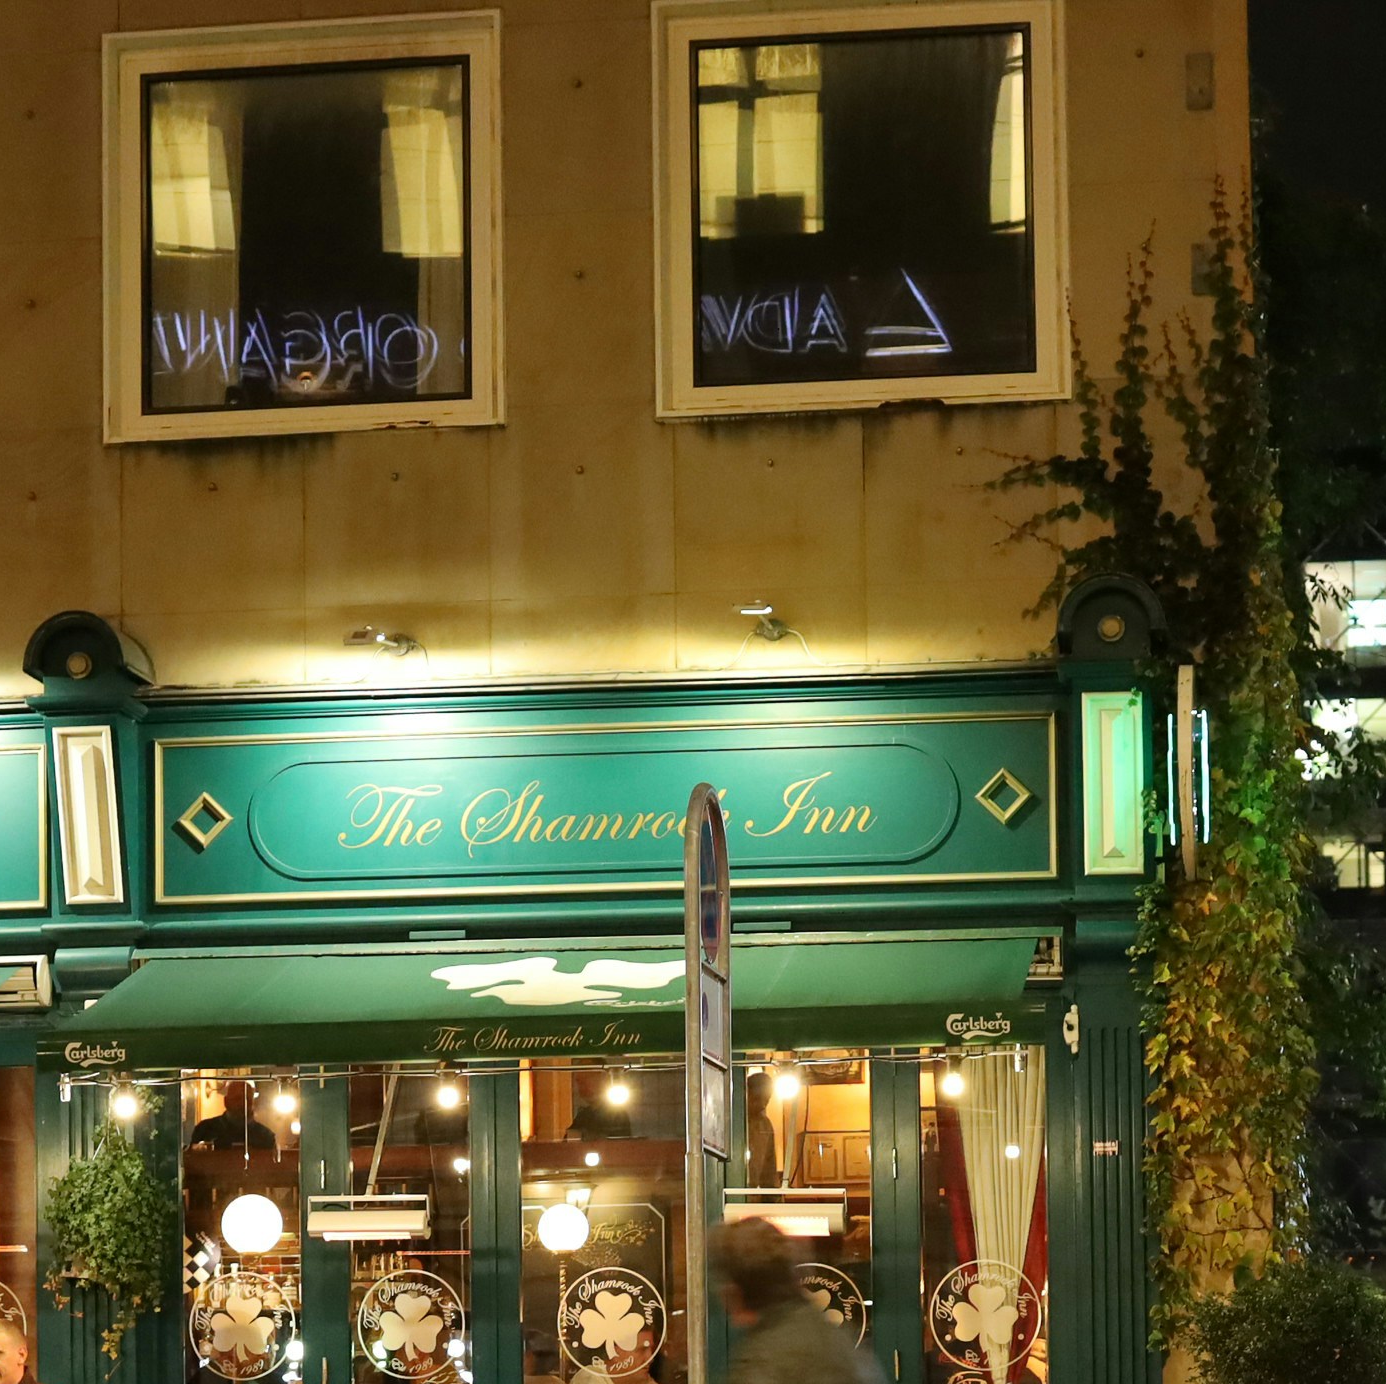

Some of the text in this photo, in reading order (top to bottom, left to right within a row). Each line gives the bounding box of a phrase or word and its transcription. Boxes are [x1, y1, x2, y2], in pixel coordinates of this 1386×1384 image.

[337, 782, 443, 850] The
[744, 770, 878, 837] Inn
[423, 1019, 641, 1055] The Shamrock Inn
[946, 1012, 1011, 1039] Carlsberg
[65, 1041, 125, 1068] Carlsberg
[362, 1279, 461, 1331] The Shamrock Inn
[565, 1277, 662, 1329] The Shamrock Inn
[837, 1291, 863, 1321] Inn
[935, 1294, 955, 1321] The
[240, 1360, 264, 1375] 1989
[409, 1357, 433, 1374] 1989
